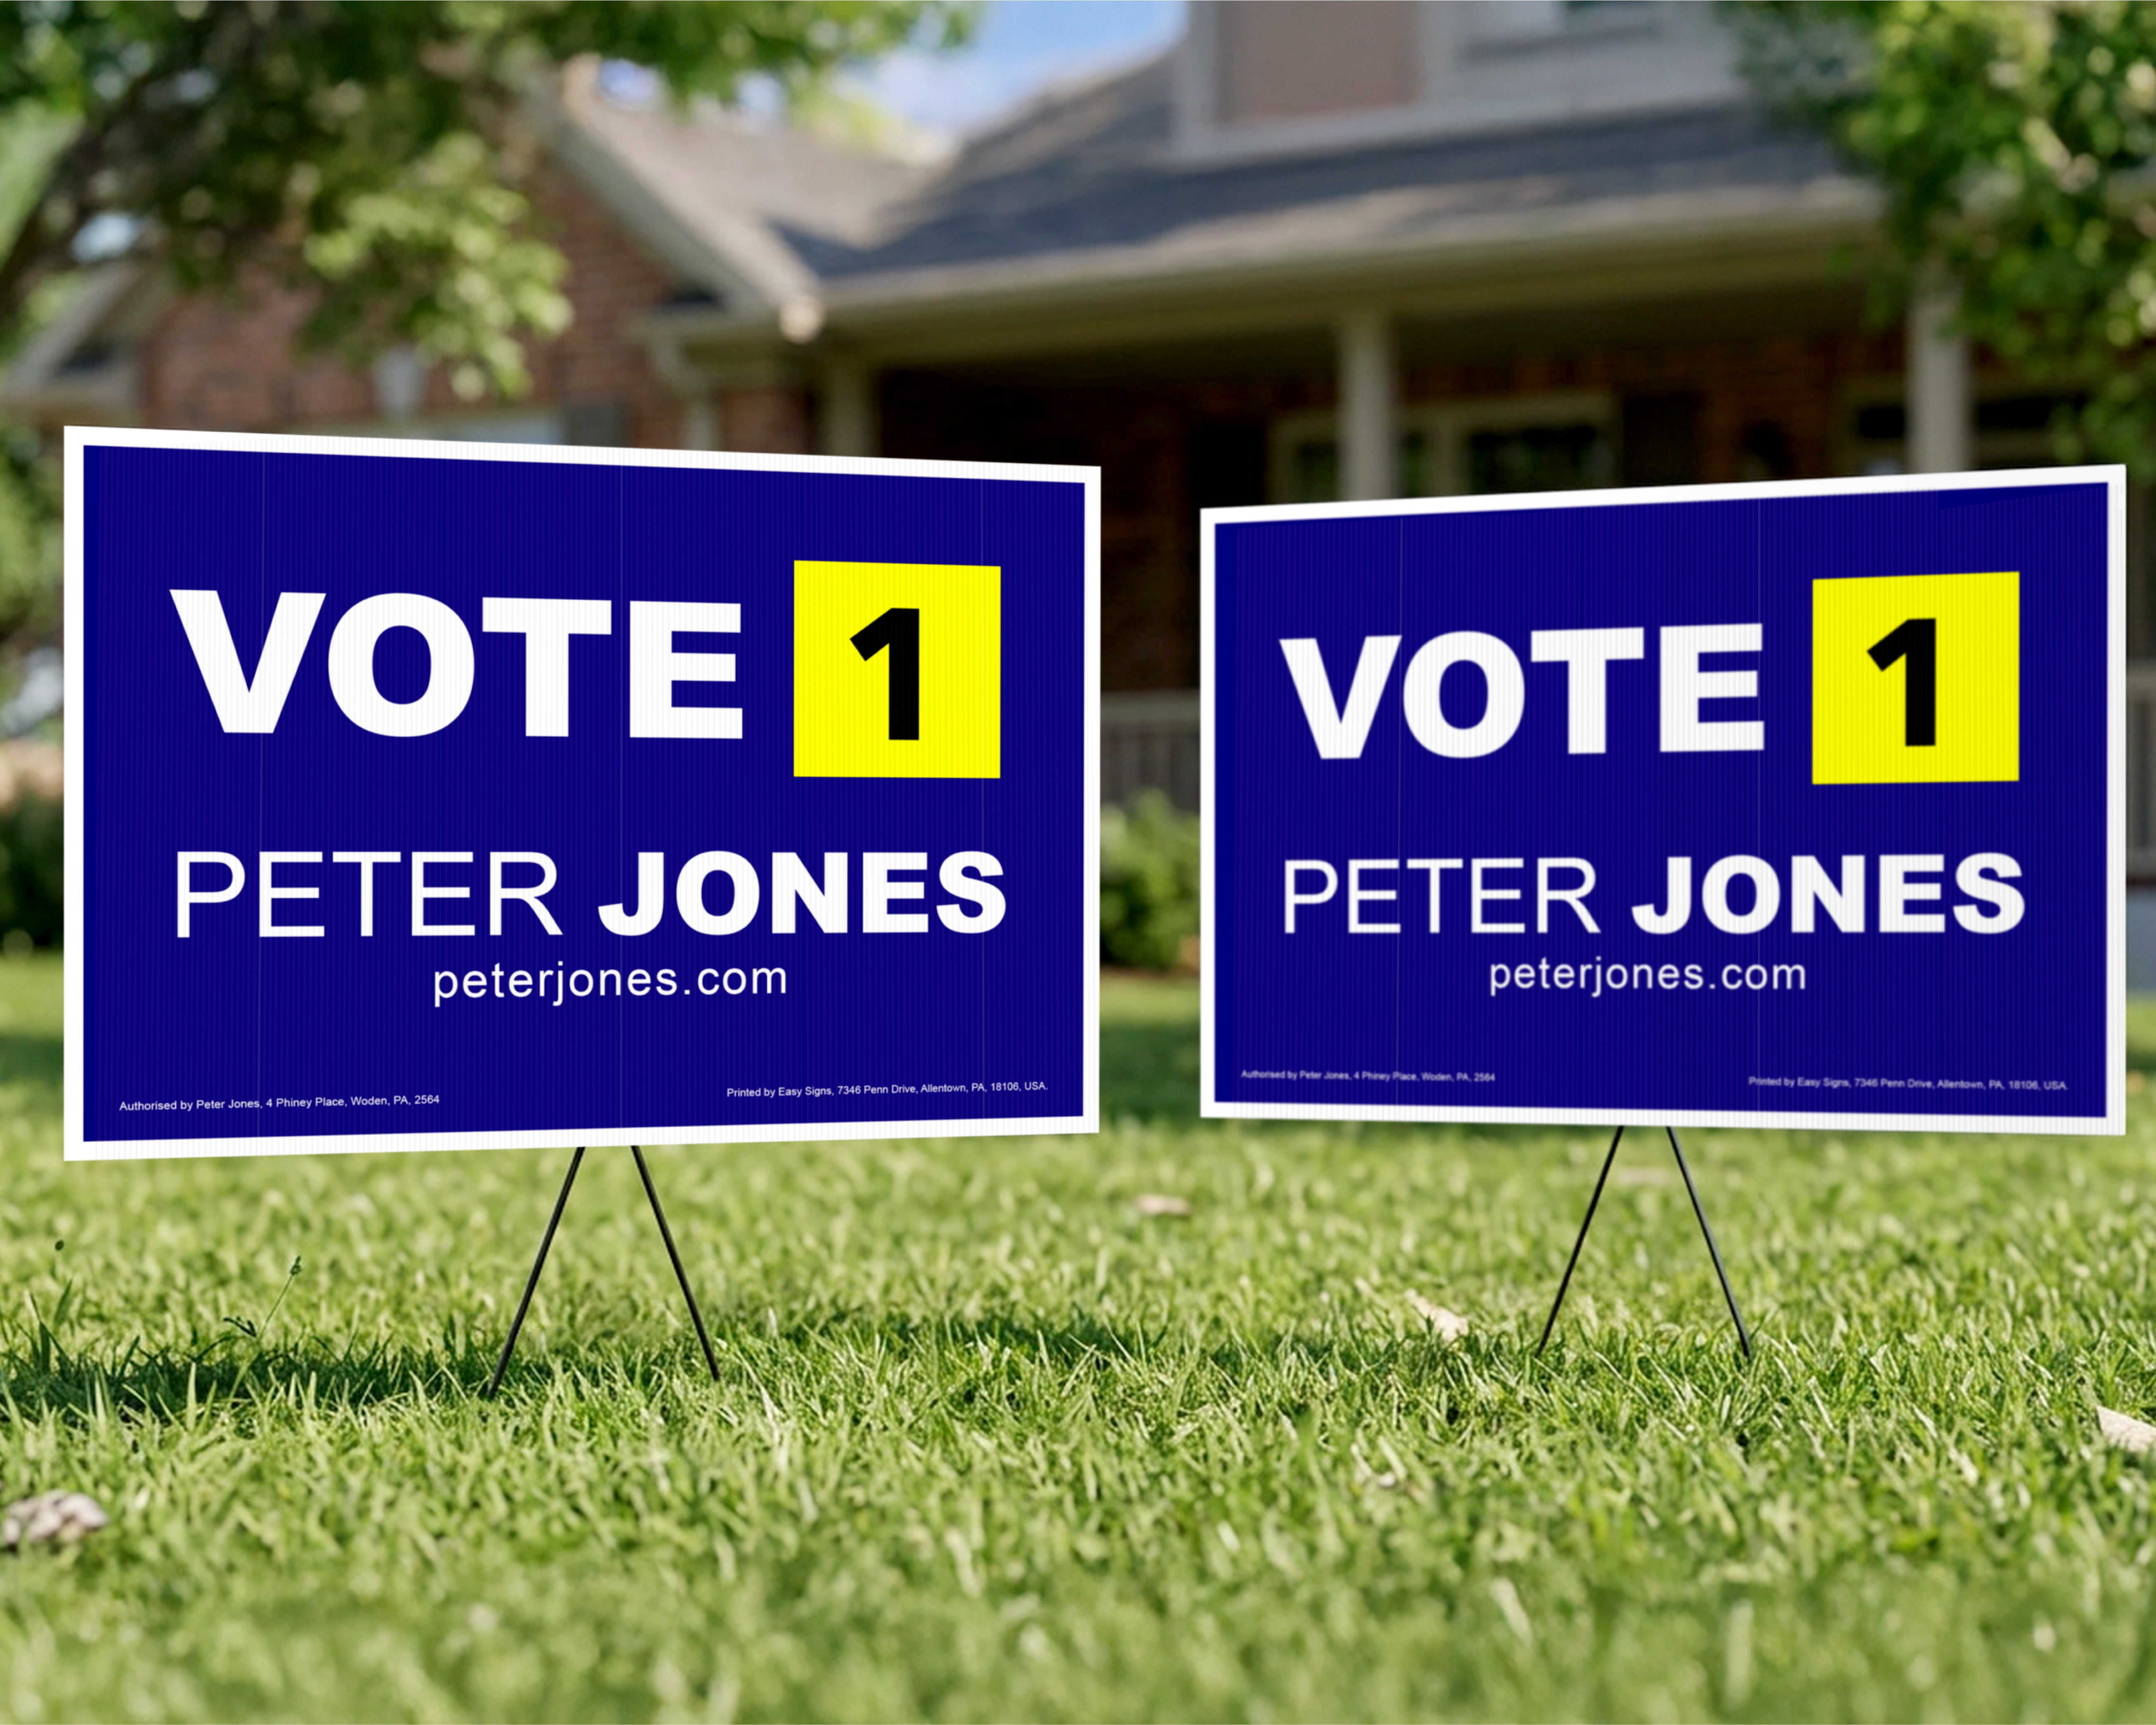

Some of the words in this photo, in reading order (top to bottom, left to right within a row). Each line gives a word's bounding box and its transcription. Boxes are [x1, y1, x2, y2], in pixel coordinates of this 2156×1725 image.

[170, 589, 743, 739] VOTE
[850, 608, 919, 740] 1
[1279, 623, 1764, 759] VOTE
[1868, 619, 1935, 746] 1
[178, 851, 562, 937] PETER
[598, 851, 1006, 936] JONES
[1285, 858, 1600, 933] PETER
[1632, 853, 2024, 934] JONES
[435, 961, 786, 1007] peterjones.com
[1491, 956, 1805, 997] peterjones.com
[727, 1088, 761, 1097] Printed
[764, 1088, 776, 1098] by
[778, 1087, 803, 1098] Easy
[805, 1086, 834, 1097] Signs,
[837, 1085, 861, 1095] 7346
[864, 1085, 889, 1094] Penn
[891, 1084, 918, 1094] Drive,
[920, 1084, 969, 1093] Allentown,
[971, 1083, 987, 1092] PA,
[991, 1082, 1021, 1091] 18106,
[1024, 1081, 1048, 1091] USA.
[1241, 1069, 1286, 1079] Authorised
[1287, 1070, 1298, 1081] by
[1299, 1070, 1322, 1079] Peter
[1324, 1071, 1352, 1081] Jones,
[1353, 1071, 1360, 1080] 4
[1361, 1070, 1391, 1082] Phiney
[1392, 1071, 1419, 1082] Place,
[1421, 1072, 1454, 1081] Woden,
[1456, 1072, 1471, 1082] PA,
[1473, 1072, 1496, 1082] 2564
[1748, 1076, 1782, 1086] Printed
[1783, 1077, 1795, 1088] by
[1797, 1076, 1821, 1088] Easy
[1823, 1077, 1851, 1089] Signs,
[1854, 1077, 1879, 1088] 7346
[1880, 1078, 1906, 1088] Penn
[1907, 1078, 1935, 1089] Drive,
[1937, 1079, 1986, 1090] Allentown,
[1988, 1079, 2005, 1090] PA,
[2009, 1080, 2041, 1091] 18106,
[2043, 1080, 2067, 1091] USA.
[119, 1100, 177, 1111] Authorised
[180, 1100, 193, 1112] by
[196, 1100, 226, 1109] Peter
[228, 1099, 263, 1109] Jones,
[266, 1098, 273, 1108] 4
[276, 1098, 312, 1109] Phiney
[315, 1097, 347, 1107] Place,
[351, 1096, 390, 1106] Woden,
[394, 1095, 411, 1105] PA,
[414, 1095, 440, 1105] 2564
